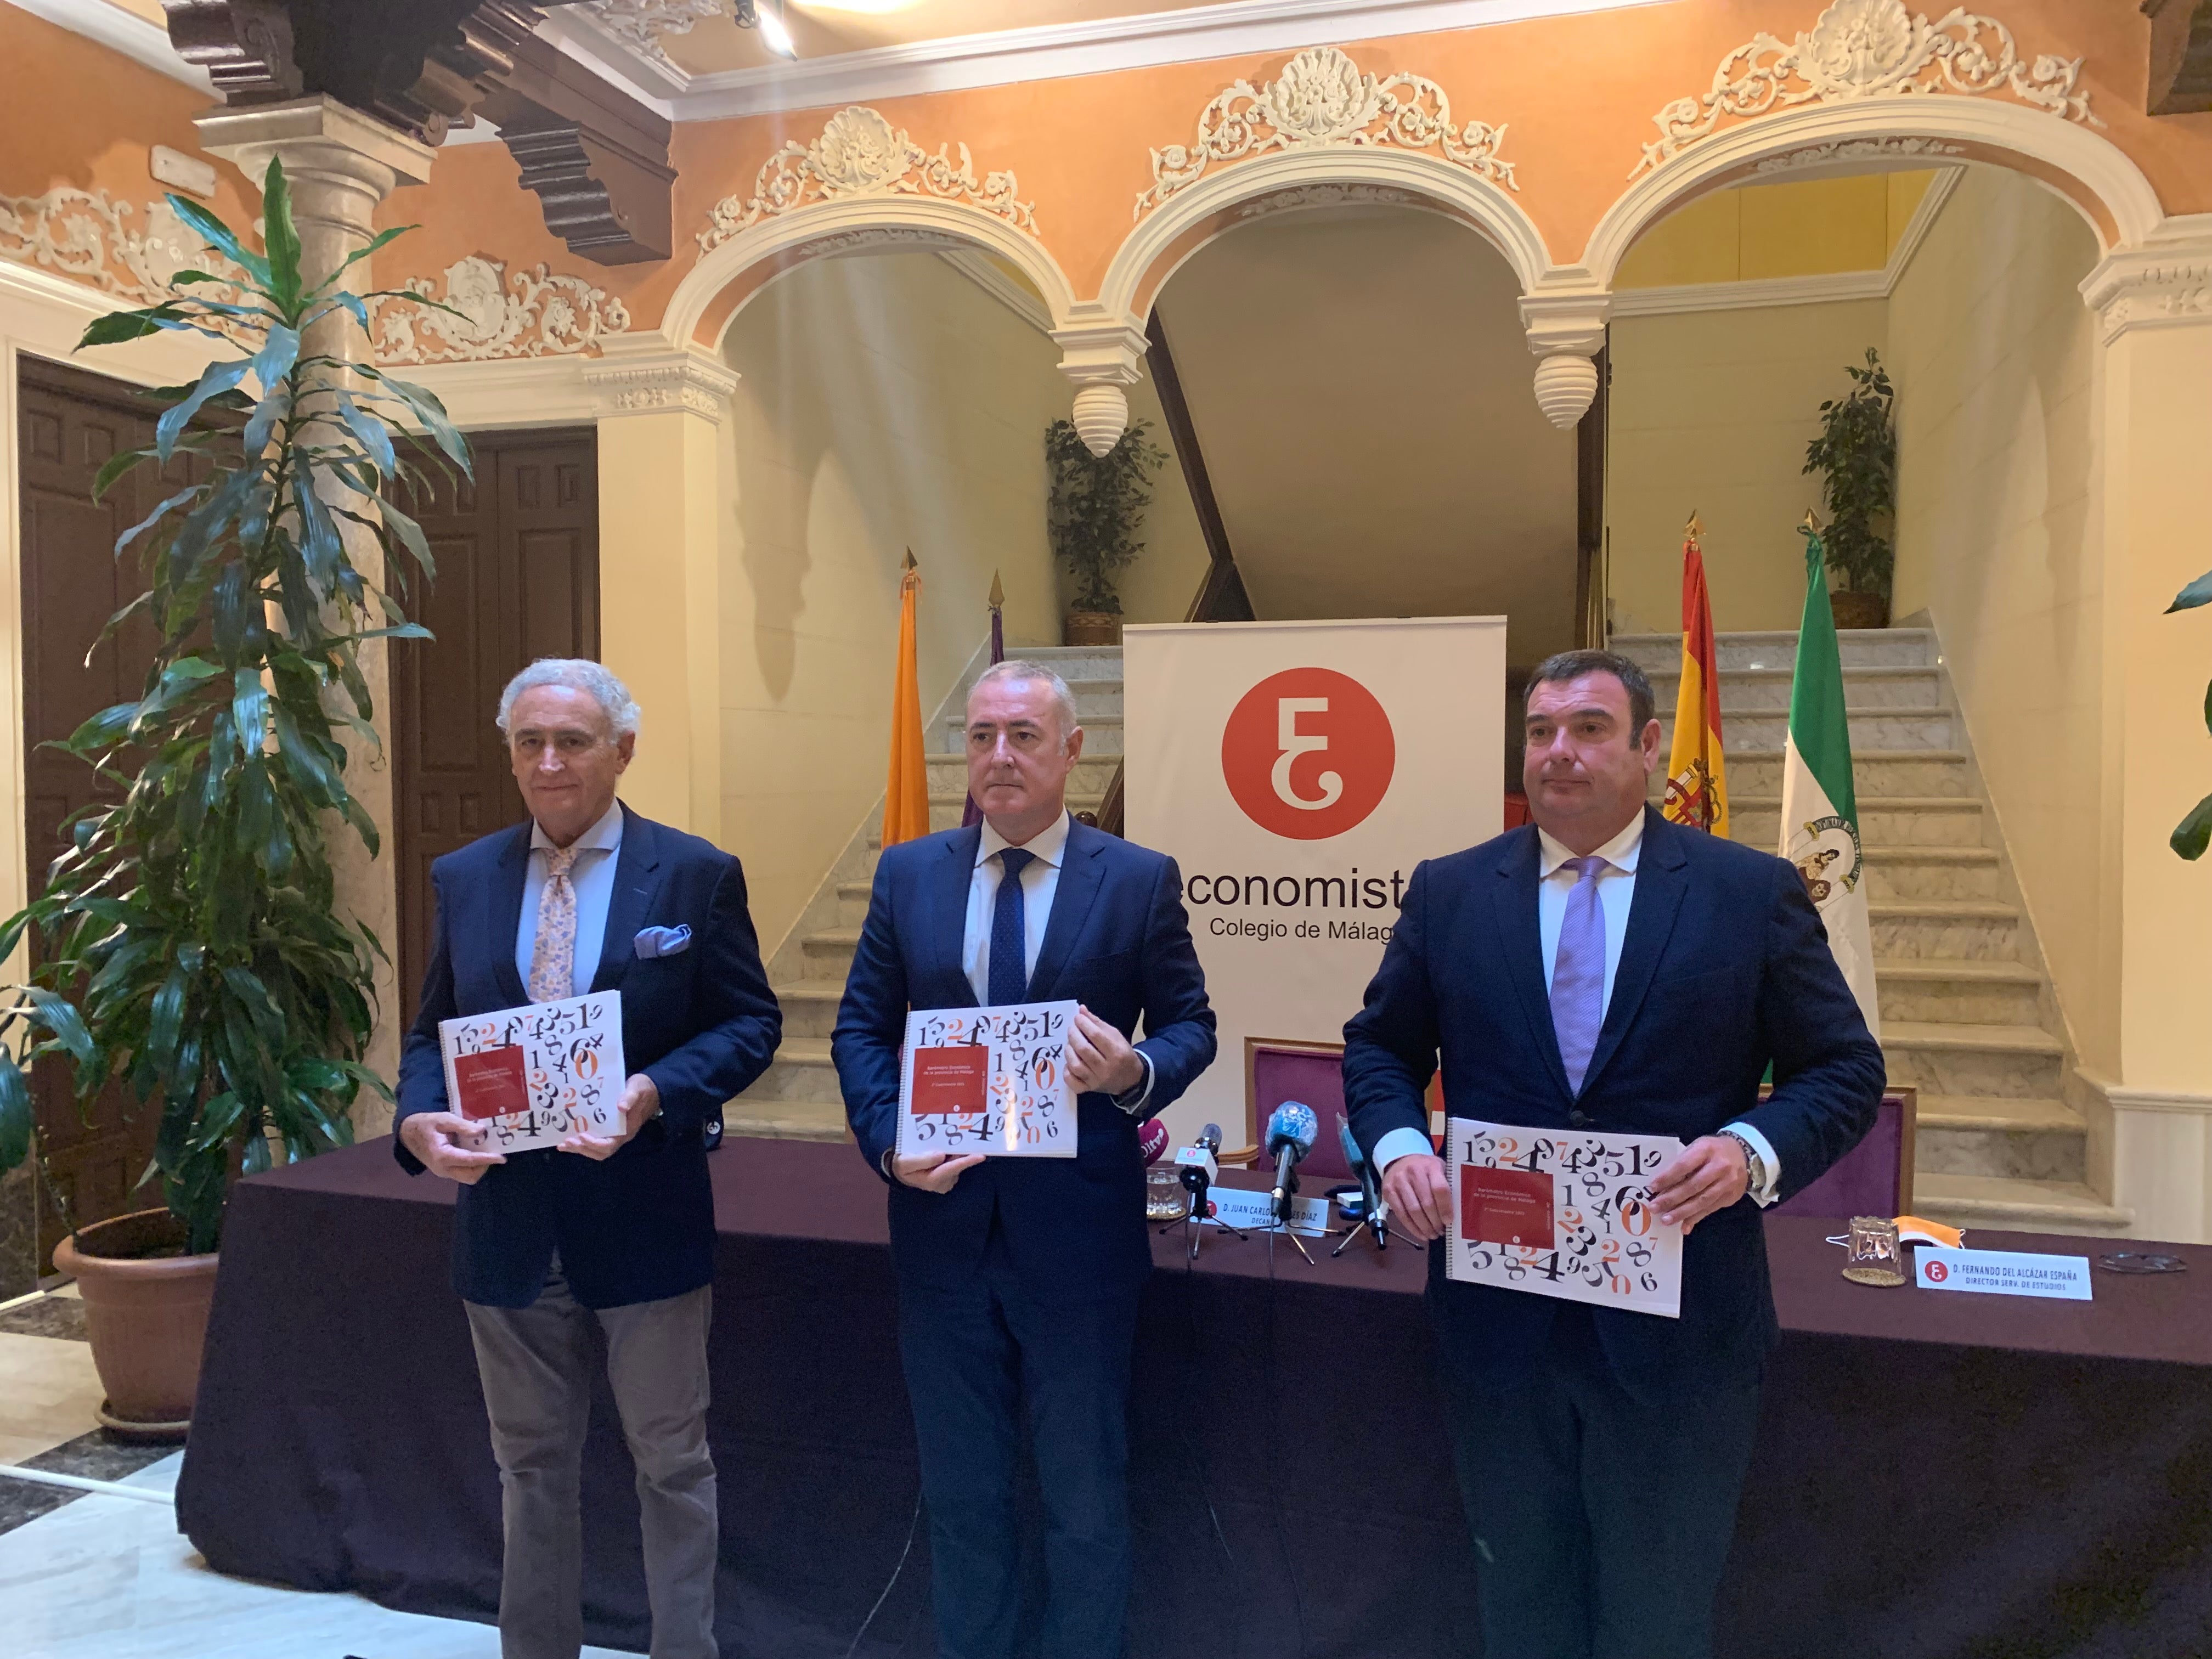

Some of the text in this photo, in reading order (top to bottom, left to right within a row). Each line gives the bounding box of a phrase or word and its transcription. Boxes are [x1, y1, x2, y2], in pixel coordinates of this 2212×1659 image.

[1180, 868, 1404, 909] conomist
[1210, 918, 1393, 945] Colegio de Málag
[453, 1036, 465, 1054] 1
[461, 1023, 478, 1042] 5
[481, 1023, 495, 1045] 2
[508, 1017, 523, 1034] 9
[525, 1015, 533, 1031] 7
[560, 1013, 575, 1035] 5
[576, 1003, 594, 1030] 1
[589, 1005, 602, 1019] 9
[917, 1027, 929, 1046] 1
[928, 1016, 945, 1035] 5
[947, 1019, 963, 1040] 2
[976, 1015, 990, 1034] 9
[993, 1016, 1001, 1032] 7
[1024, 1019, 1039, 1041] 5
[1039, 1011, 1054, 1038] 1
[1051, 1014, 1063, 1029] 9
[530, 1038, 598, 1080] 1 4 6 0
[545, 1034, 562, 1056] 8
[1010, 1039, 1025, 1060] 8
[1050, 1044, 1063, 1061] 4
[529, 1069, 548, 1092] 2
[597, 1076, 604, 1088] 7
[994, 1047, 1055, 1090] 1 4 6 0
[537, 1082, 600, 1109] 3 2 8
[990, 1074, 1009, 1096] 2
[1053, 1089, 1059, 1101] 7
[1021, 1096, 1034, 1116] 2
[1037, 1095, 1054, 1117] 8
[496, 1125, 515, 1146] 8
[517, 1110, 541, 1137] 4
[541, 1111, 550, 1126] 9
[594, 1108, 606, 1124] 6
[915, 1114, 935, 1141] 5
[945, 1125, 963, 1146] 8
[968, 1114, 993, 1142] 4
[995, 1116, 1005, 1132] 9
[1047, 1120, 1058, 1138] 6
[1463, 1141, 1477, 1163] 1
[1474, 1131, 1496, 1152] 5
[1498, 1137, 1518, 1163] 2
[1534, 1138, 1554, 1159] 9
[1556, 1142, 1568, 1160] 7
[1603, 1151, 1624, 1177] 5
[1624, 1144, 1649, 1176] 1
[1644, 1151, 1662, 1167] 9
[1582, 1172, 1606, 1197] 8
[1231, 1205, 1248, 1214] JUAN
[1250, 1206, 1272, 1216] CARLO
[1301, 1211, 1317, 1221] DÍAZ
[1561, 1184, 1651, 1236] 1 4 6 0
[1557, 1207, 1583, 1233] 2
[1604, 1221, 1613, 1234] 1
[1650, 1237, 1658, 1250] 7
[1566, 1226, 1651, 1267] 3 2 8
[1468, 1241, 1492, 1269] 5
[1504, 1257, 1526, 1281] 8
[1532, 1251, 1565, 1284] 4
[1567, 1256, 1581, 1273] 9
[1641, 1272, 1657, 1291] 6
[1953, 1264, 2077, 1281] D. FERNANDO DEL ALCÁZAR ESPAÑA
[1966, 1277, 1999, 1286] DIRECTOR
[2001, 1279, 2019, 1288] SERV.
[2032, 1282, 2066, 1290] ESTUDIOS
